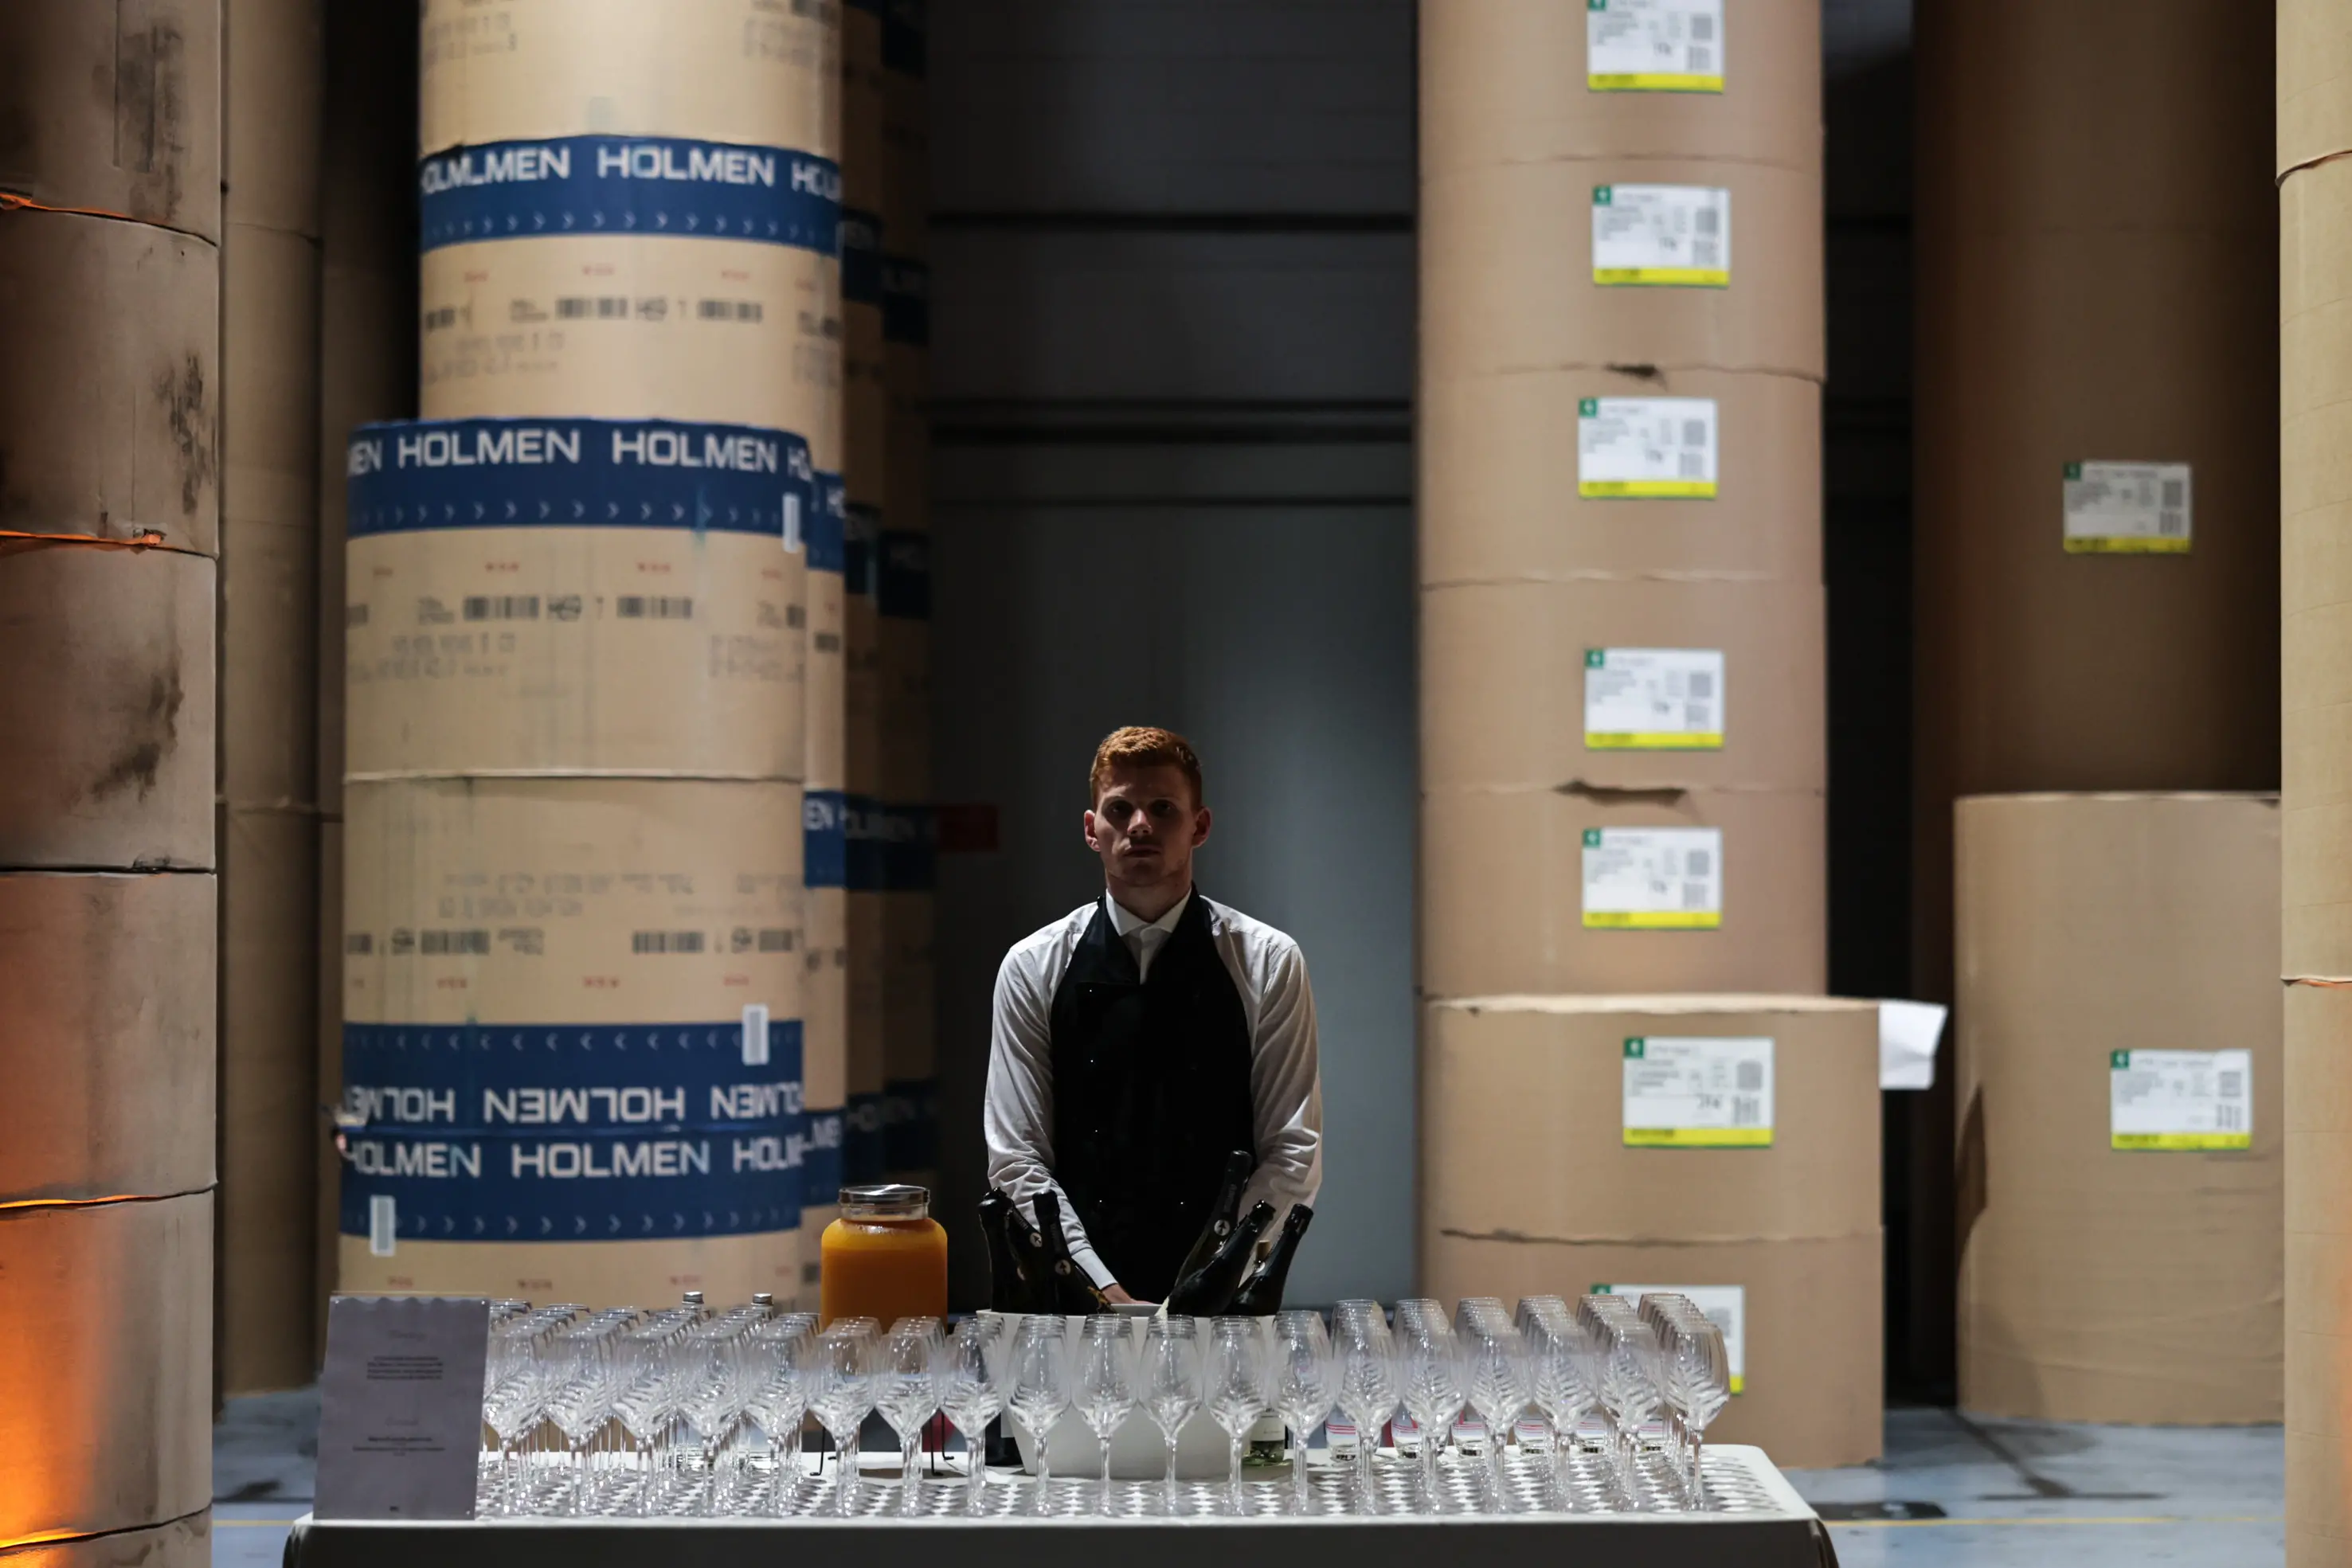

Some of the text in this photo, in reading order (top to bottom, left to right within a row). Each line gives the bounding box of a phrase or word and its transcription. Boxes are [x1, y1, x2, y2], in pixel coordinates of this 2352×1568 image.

[597, 144, 775, 187] HOLMEN
[397, 428, 580, 468] HOLMEN
[612, 430, 777, 473] HOLMEN
[483, 1086, 686, 1124] HOLMEN
[511, 1140, 710, 1179] HOLMEN
